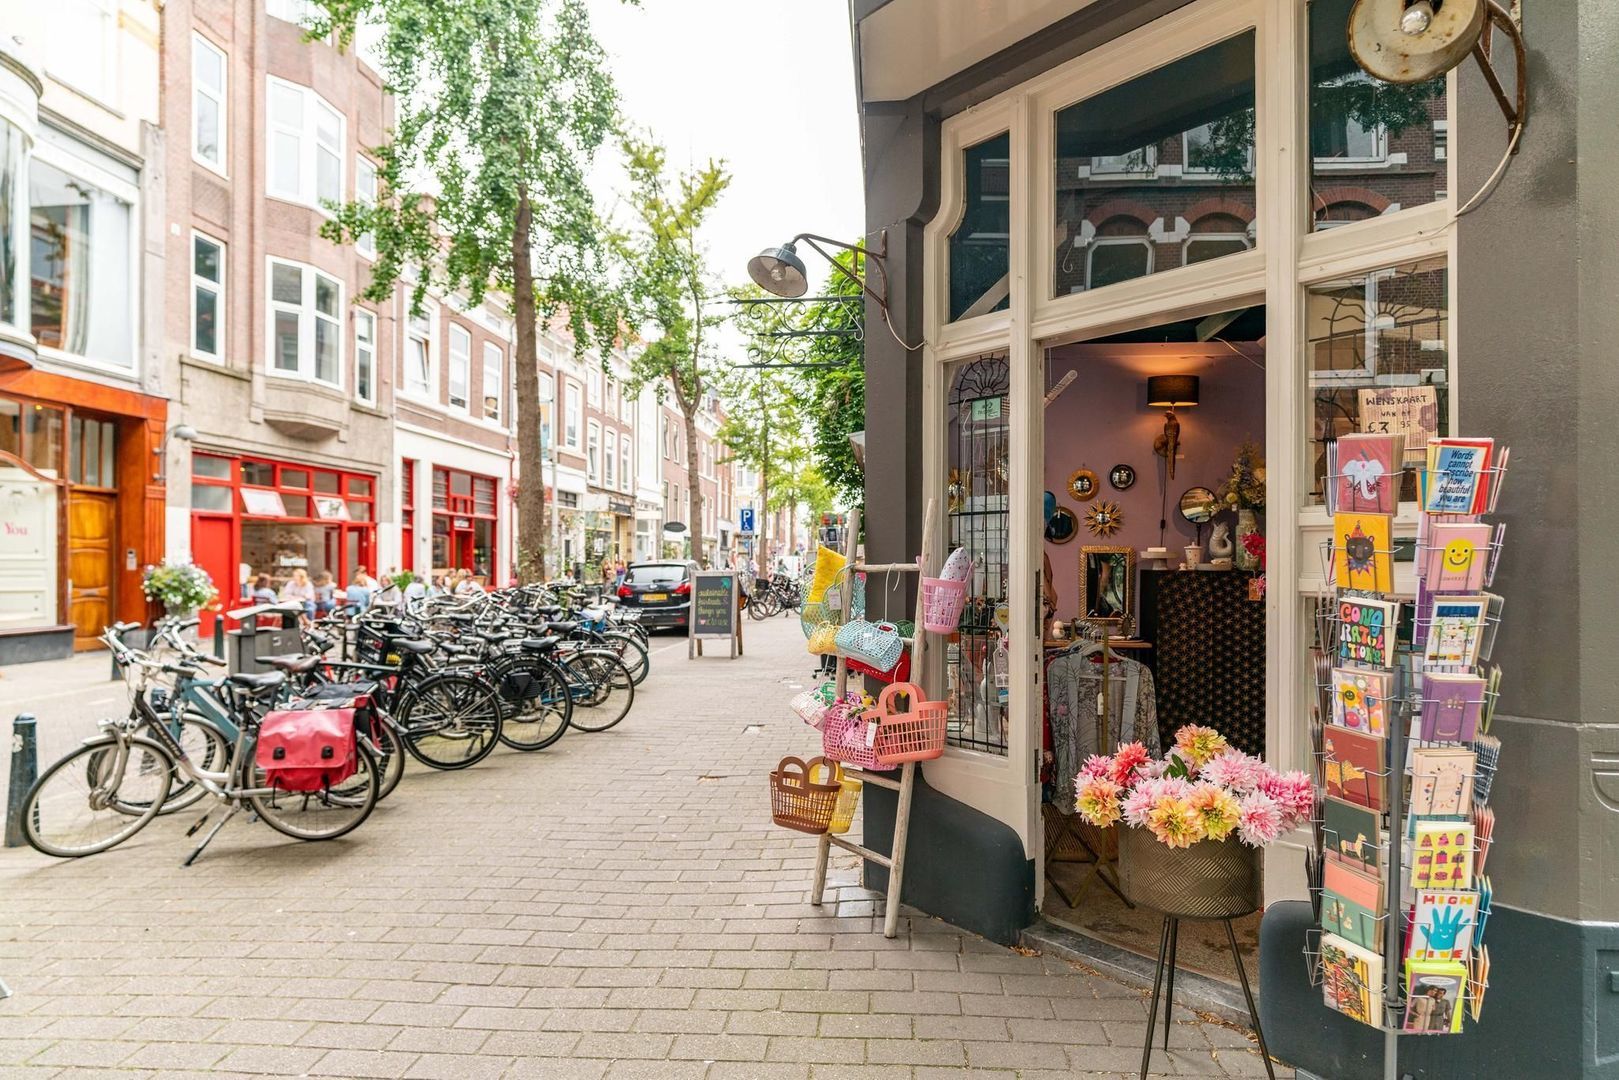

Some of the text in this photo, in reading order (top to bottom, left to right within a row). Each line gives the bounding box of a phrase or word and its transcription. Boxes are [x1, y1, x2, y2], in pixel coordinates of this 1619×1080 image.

[1366, 394, 1427, 406] WENSKAART
[1451, 450, 1475, 460] Words
[1448, 460, 1473, 468] cannot
[1442, 468, 1474, 477] describe
[1448, 477, 1465, 485] how
[1438, 485, 1471, 494] beautiful
[1438, 494, 1452, 503] you
[743, 510, 751, 522] P
[4, 522, 28, 536] You
[1423, 895, 1473, 905] HIGH
[1415, 949, 1464, 959] FIVE
